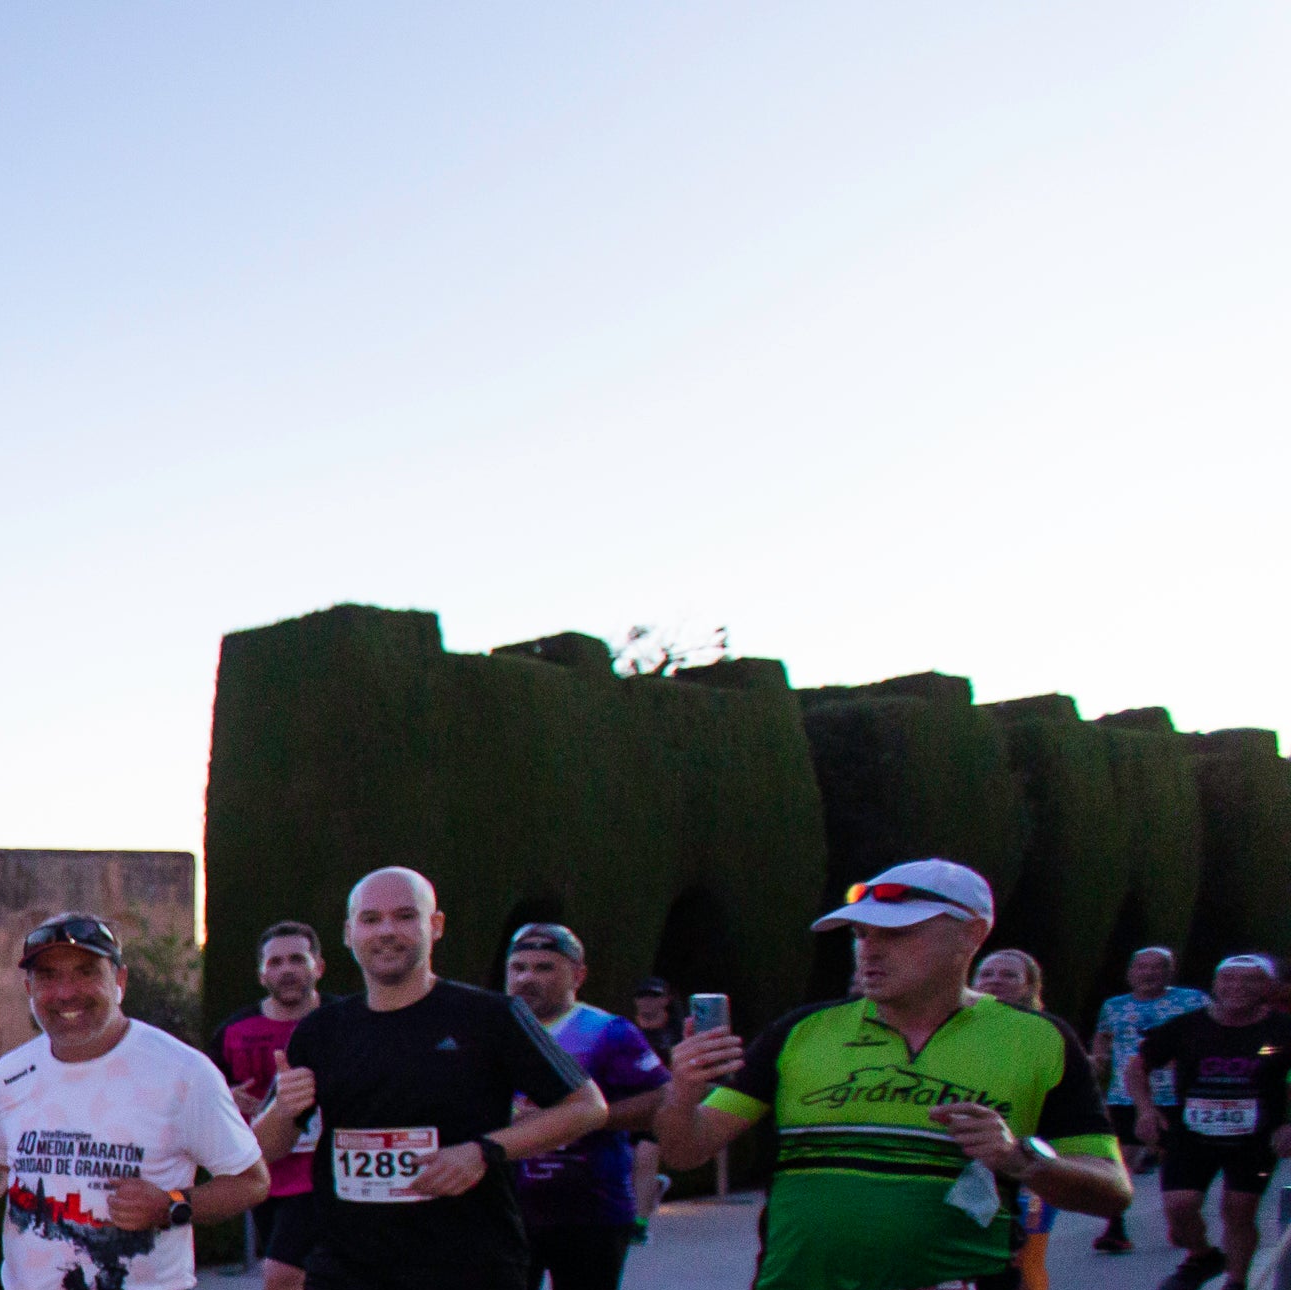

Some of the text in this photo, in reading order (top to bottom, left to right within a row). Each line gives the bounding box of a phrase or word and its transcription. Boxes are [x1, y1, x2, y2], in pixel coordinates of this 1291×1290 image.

[17, 1130, 145, 1163] 40 MEDIA MARATÓN
[56, 1158, 71, 1176] DE
[74, 1159, 142, 1178] GRANADA
[339, 1151, 419, 1178] 1289
